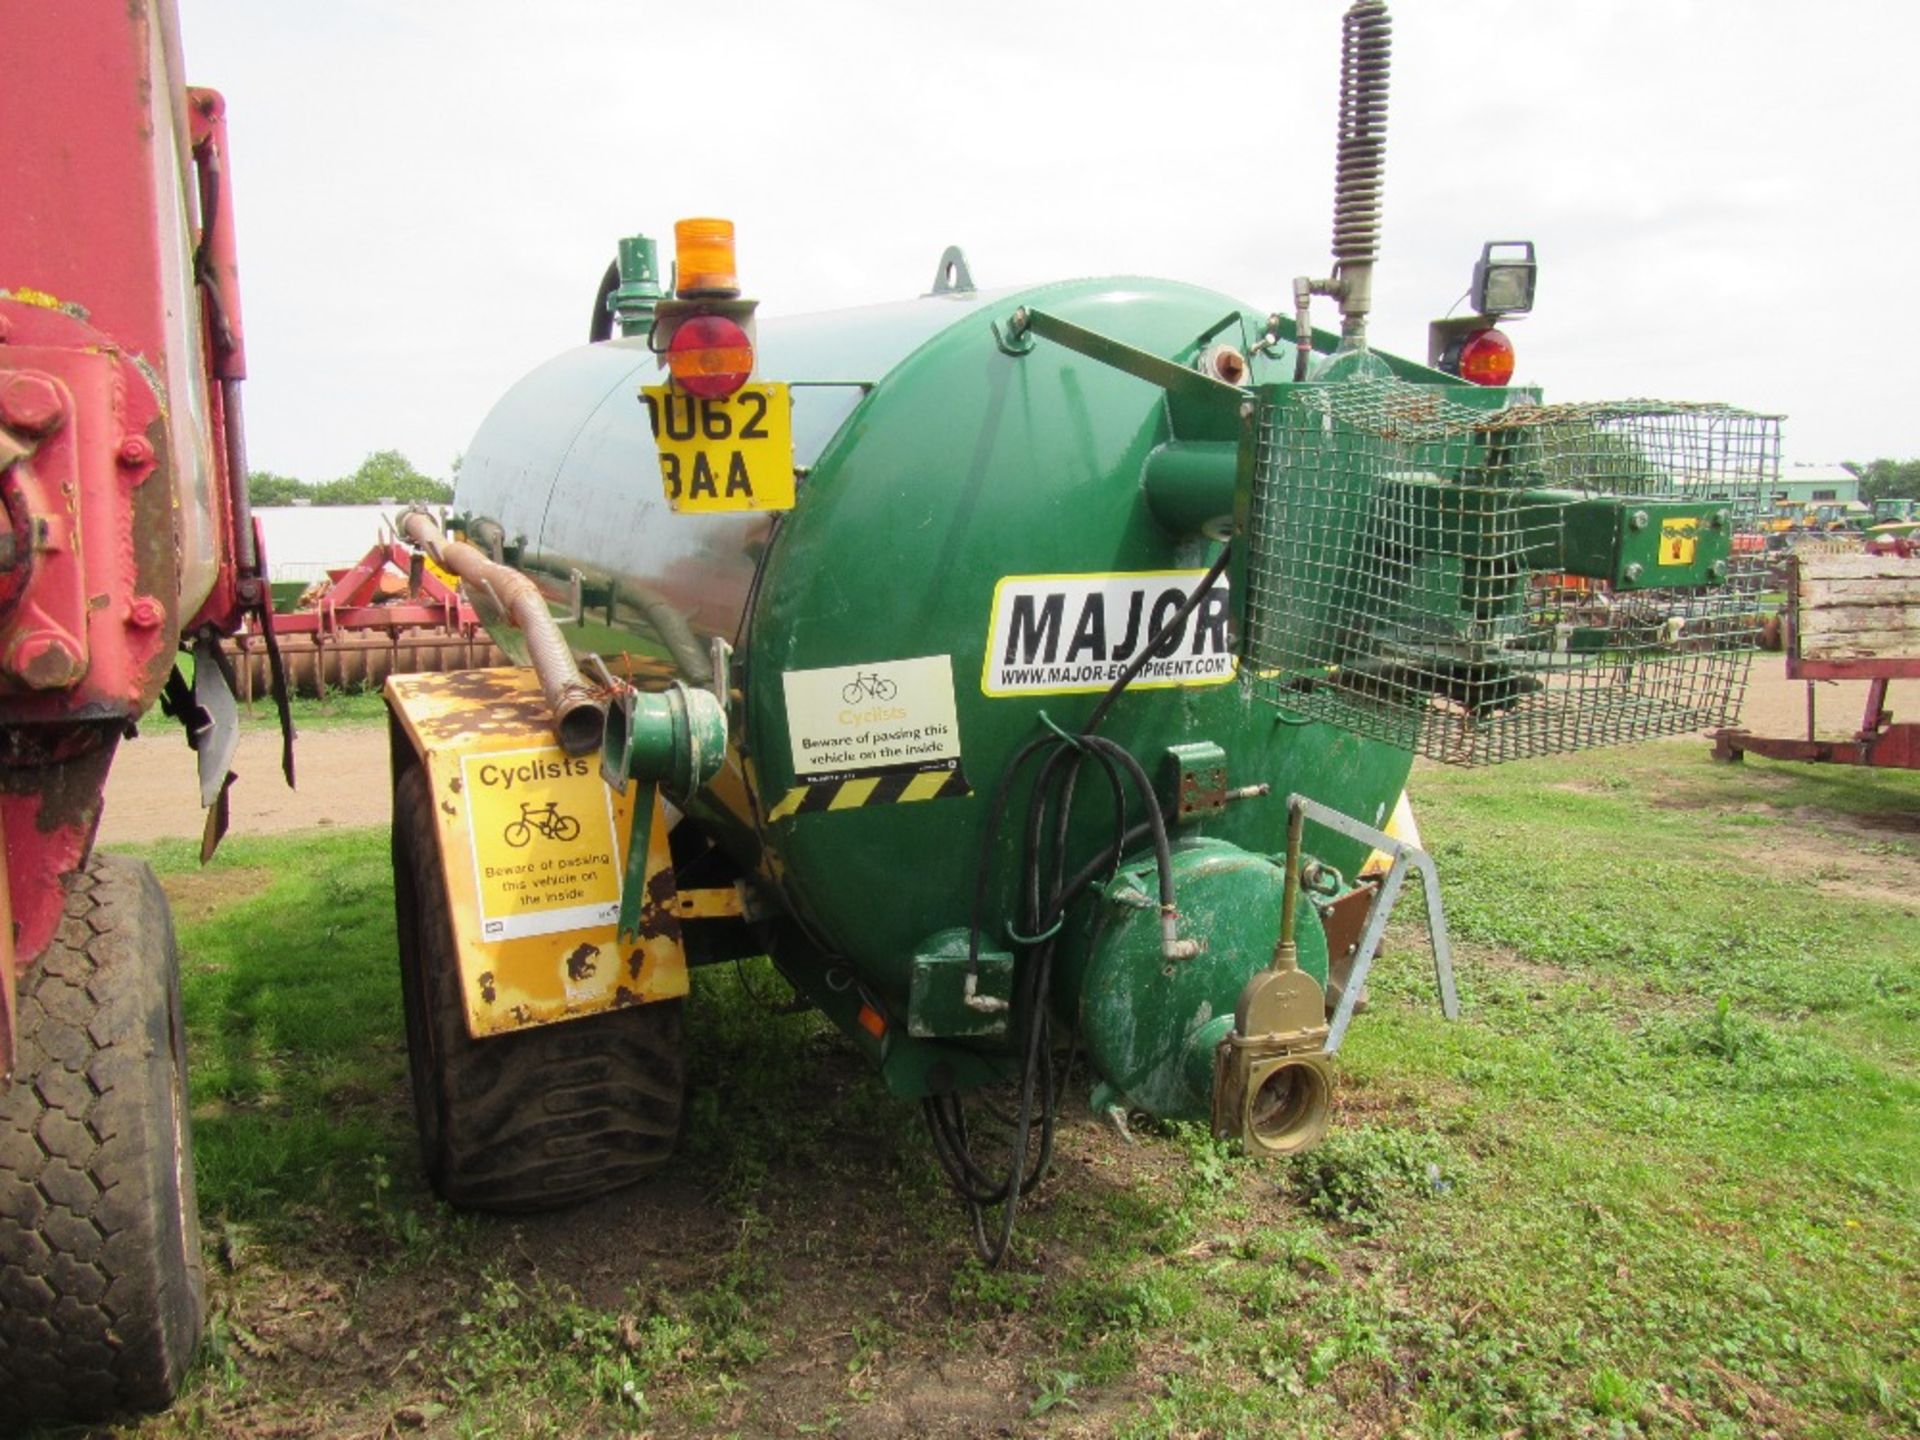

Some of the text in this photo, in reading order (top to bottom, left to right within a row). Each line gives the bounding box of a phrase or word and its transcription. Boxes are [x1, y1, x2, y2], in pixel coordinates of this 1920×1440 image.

[1004, 588, 1228, 665] MAJOR
[1001, 658, 1226, 685] WWW.MAJOR-EQIPMENT.COM
[838, 706, 907, 727] Cyclists
[802, 723, 948, 749] Beware of passing this
[810, 741, 944, 765] vehicle on the inside
[480, 757, 589, 790] Cyclists
[485, 853, 610, 878] Beware of passing
[502, 869, 599, 892] this vehicle on
[520, 889, 585, 906] the inside
